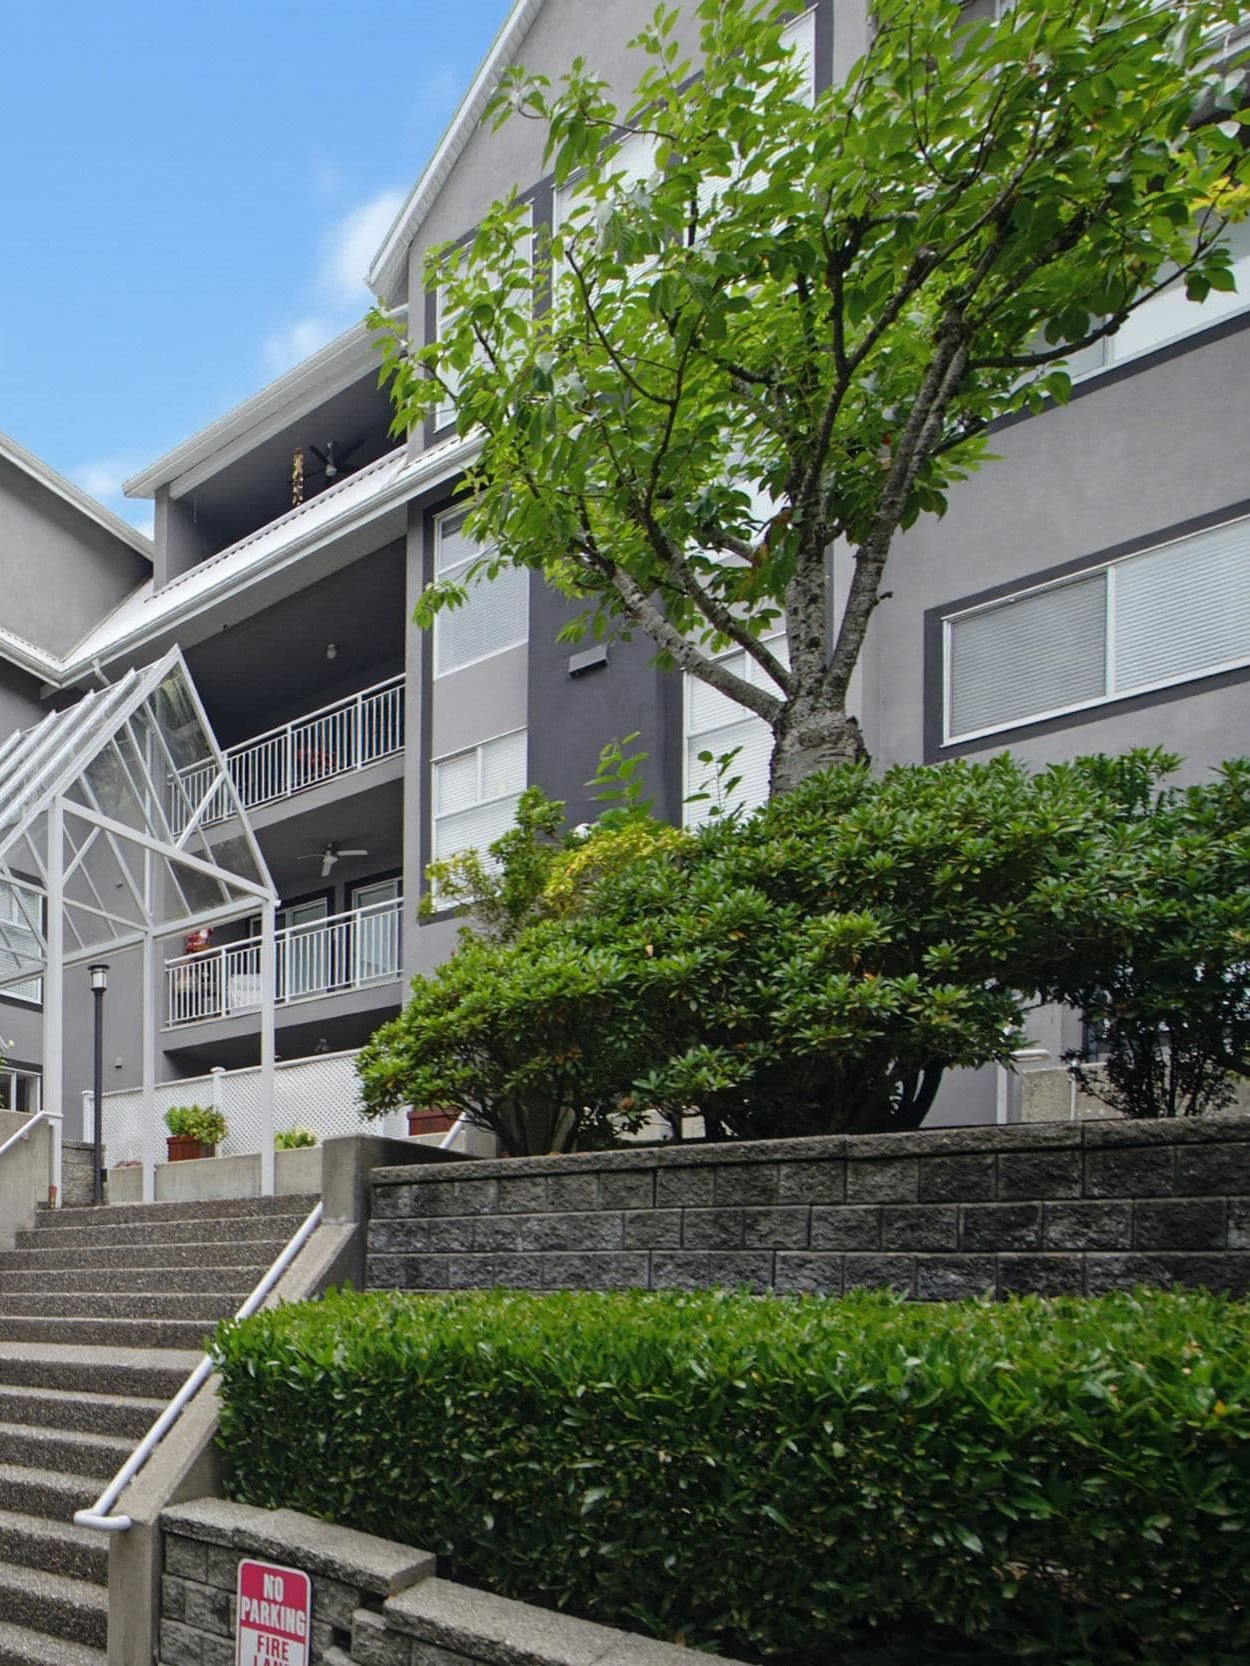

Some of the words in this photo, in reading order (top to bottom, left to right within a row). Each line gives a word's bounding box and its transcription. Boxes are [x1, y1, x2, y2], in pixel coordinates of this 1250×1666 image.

[263, 1573, 284, 1602] NO
[241, 1596, 306, 1636] PARKING
[257, 1634, 289, 1661] FIRE
